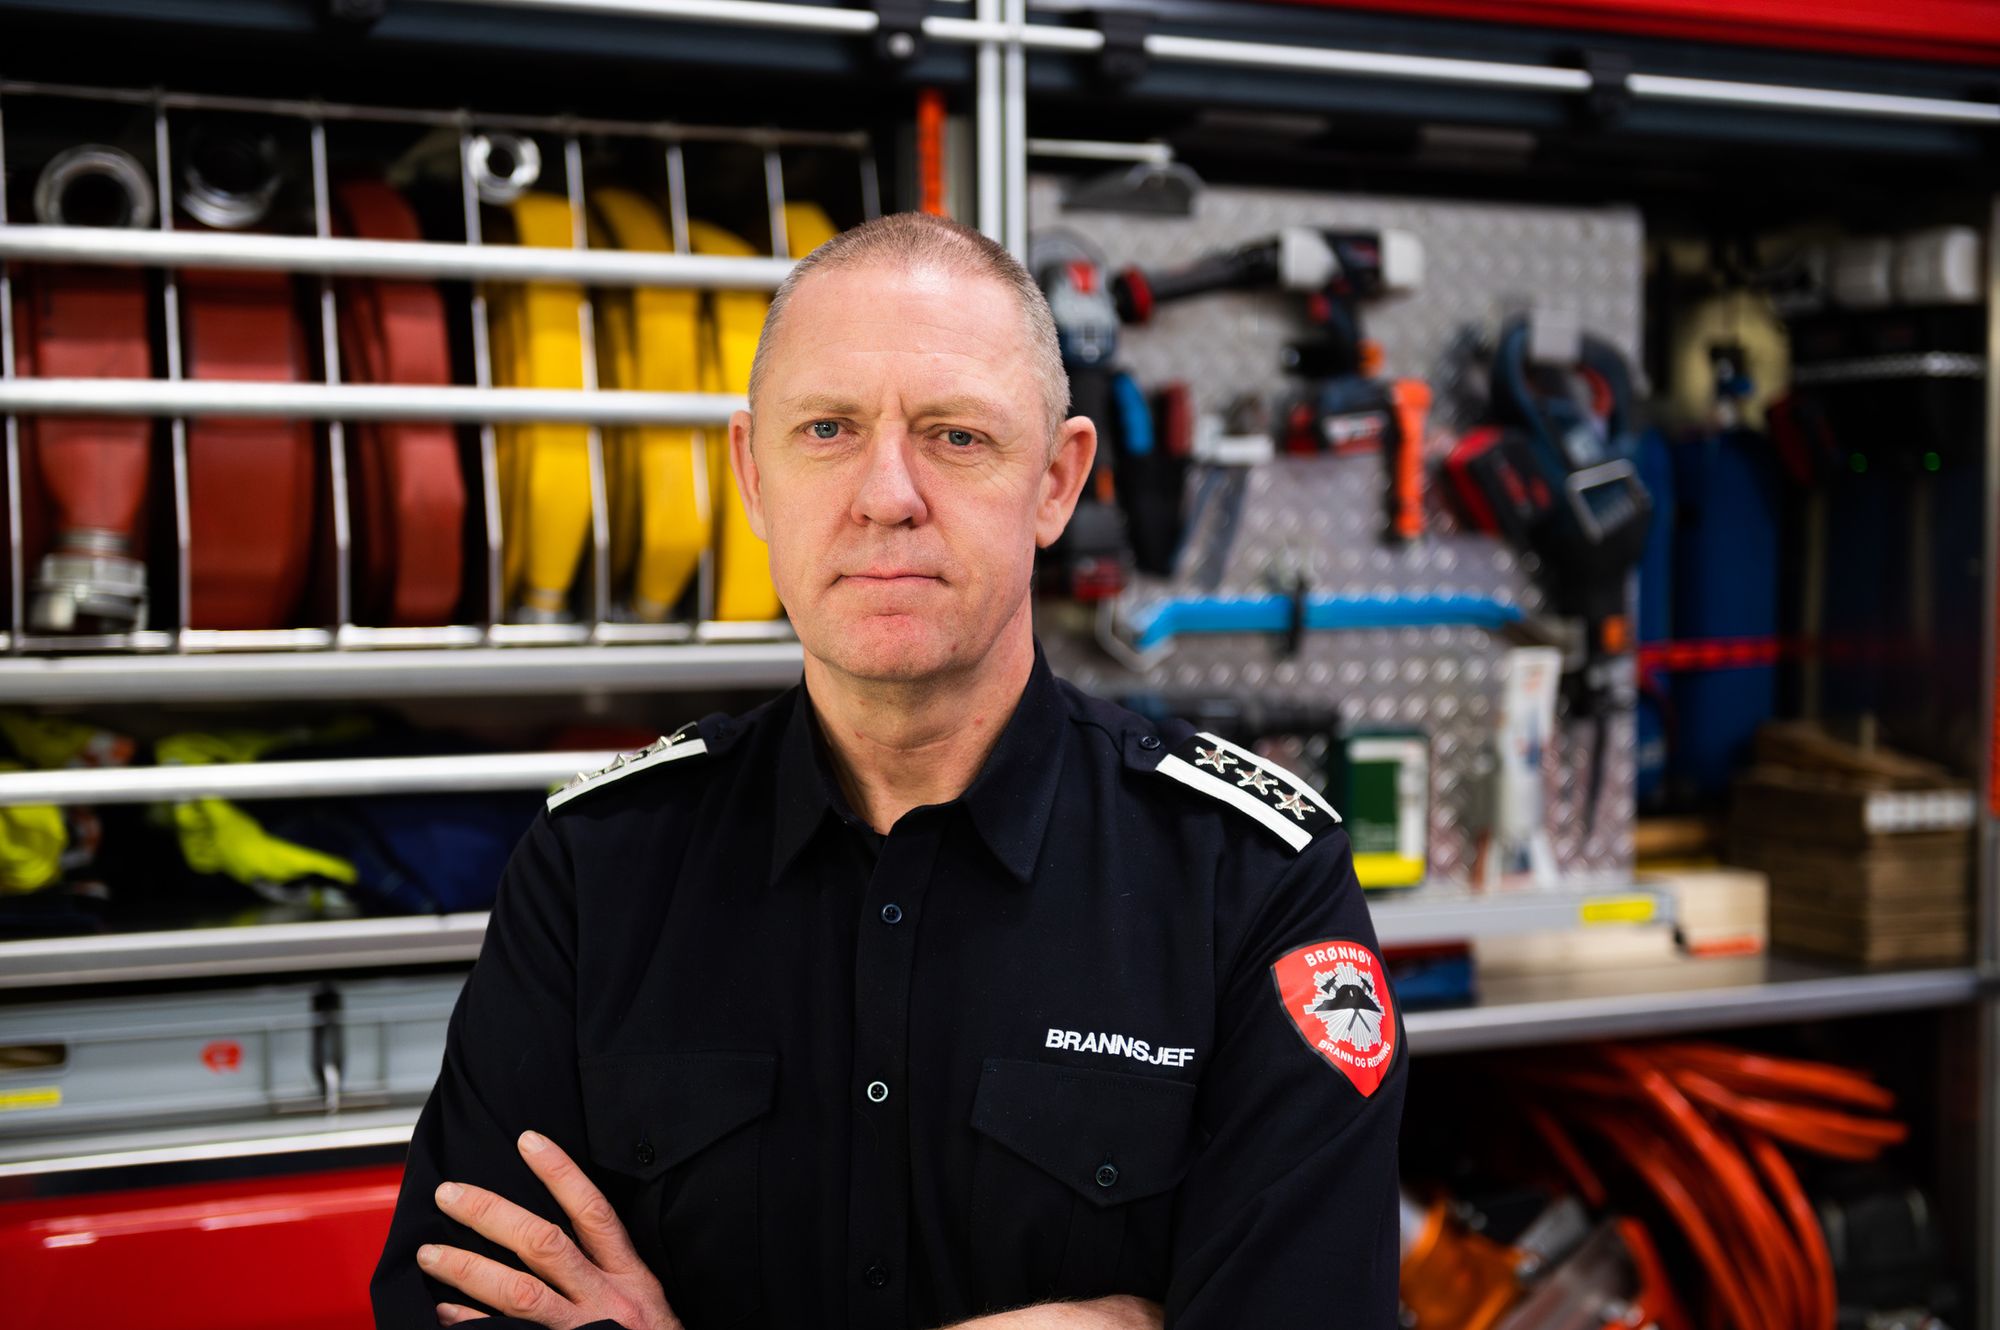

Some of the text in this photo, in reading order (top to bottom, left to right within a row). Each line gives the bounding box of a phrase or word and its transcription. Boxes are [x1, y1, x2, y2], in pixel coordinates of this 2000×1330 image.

[1304, 946, 1372, 968] BRØNNØY
[1045, 1028, 1195, 1067] BRANNSJEF
[1318, 1039, 1354, 1065] BRANN
[1355, 1056, 1367, 1069] OG
